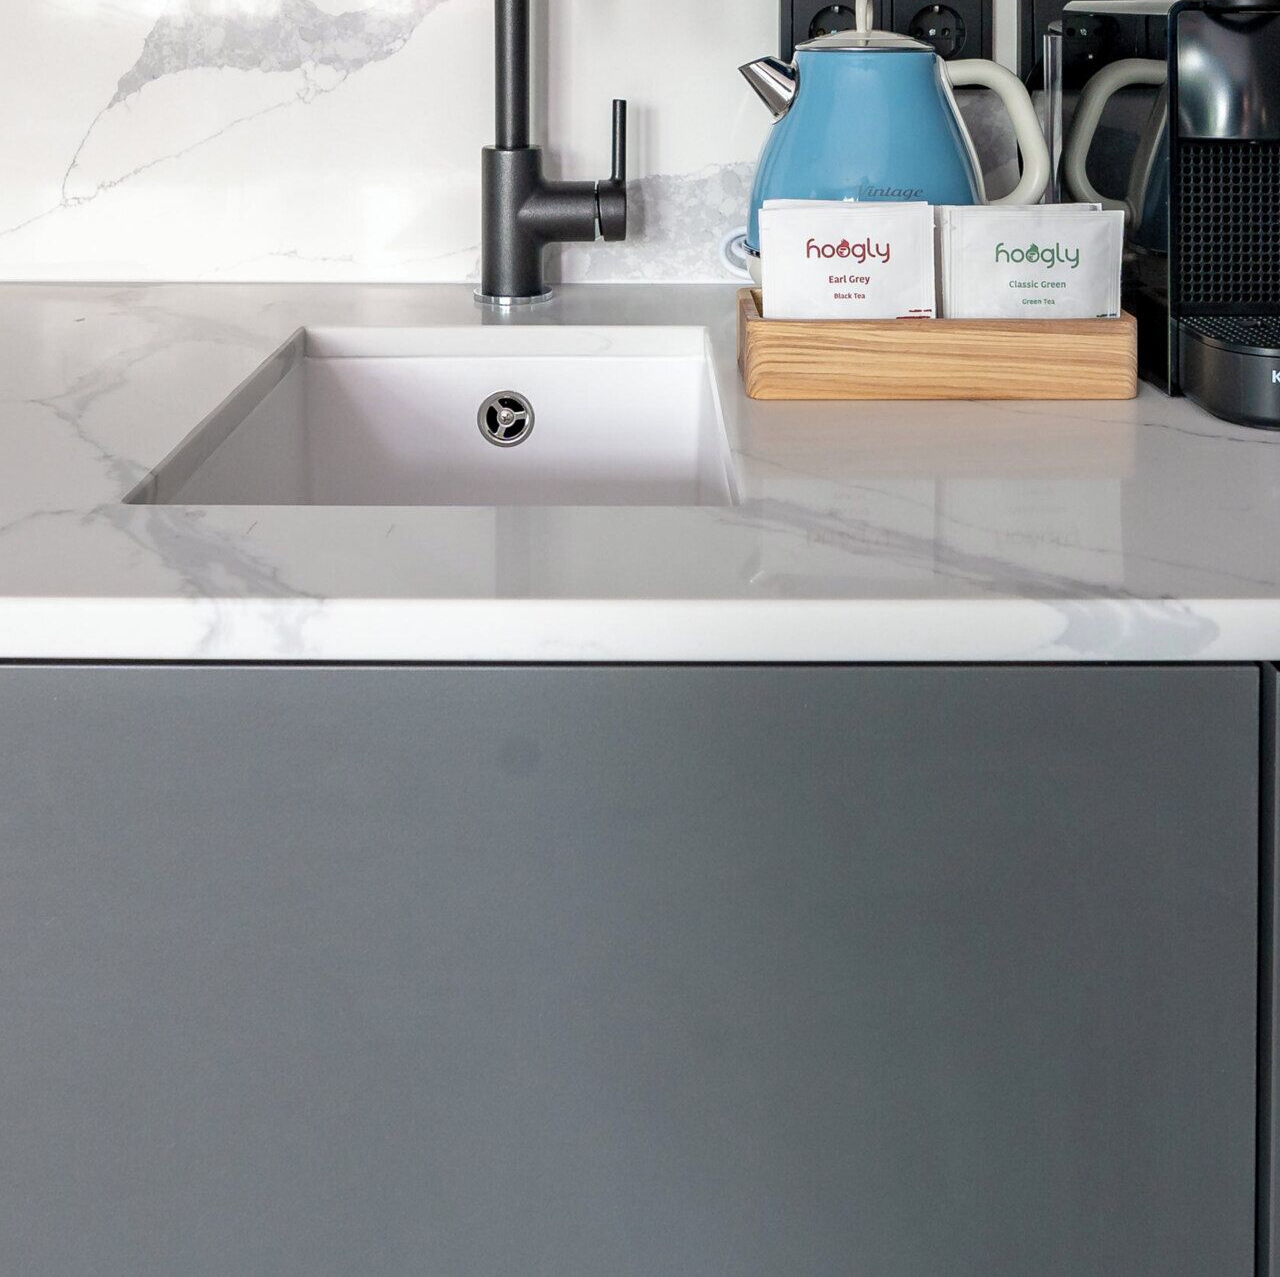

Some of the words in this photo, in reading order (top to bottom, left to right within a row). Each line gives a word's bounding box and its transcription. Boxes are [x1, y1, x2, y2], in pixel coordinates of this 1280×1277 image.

[859, 184, 924, 200] Vintage
[806, 237, 891, 263] hoogly
[995, 242, 1080, 268] hoogly
[828, 275, 847, 284] Earl
[849, 275, 870, 285] Grey
[1009, 280, 1039, 289] Classic
[1041, 280, 1067, 289] Green
[833, 292, 852, 300] Black
[854, 292, 866, 300] Tea
